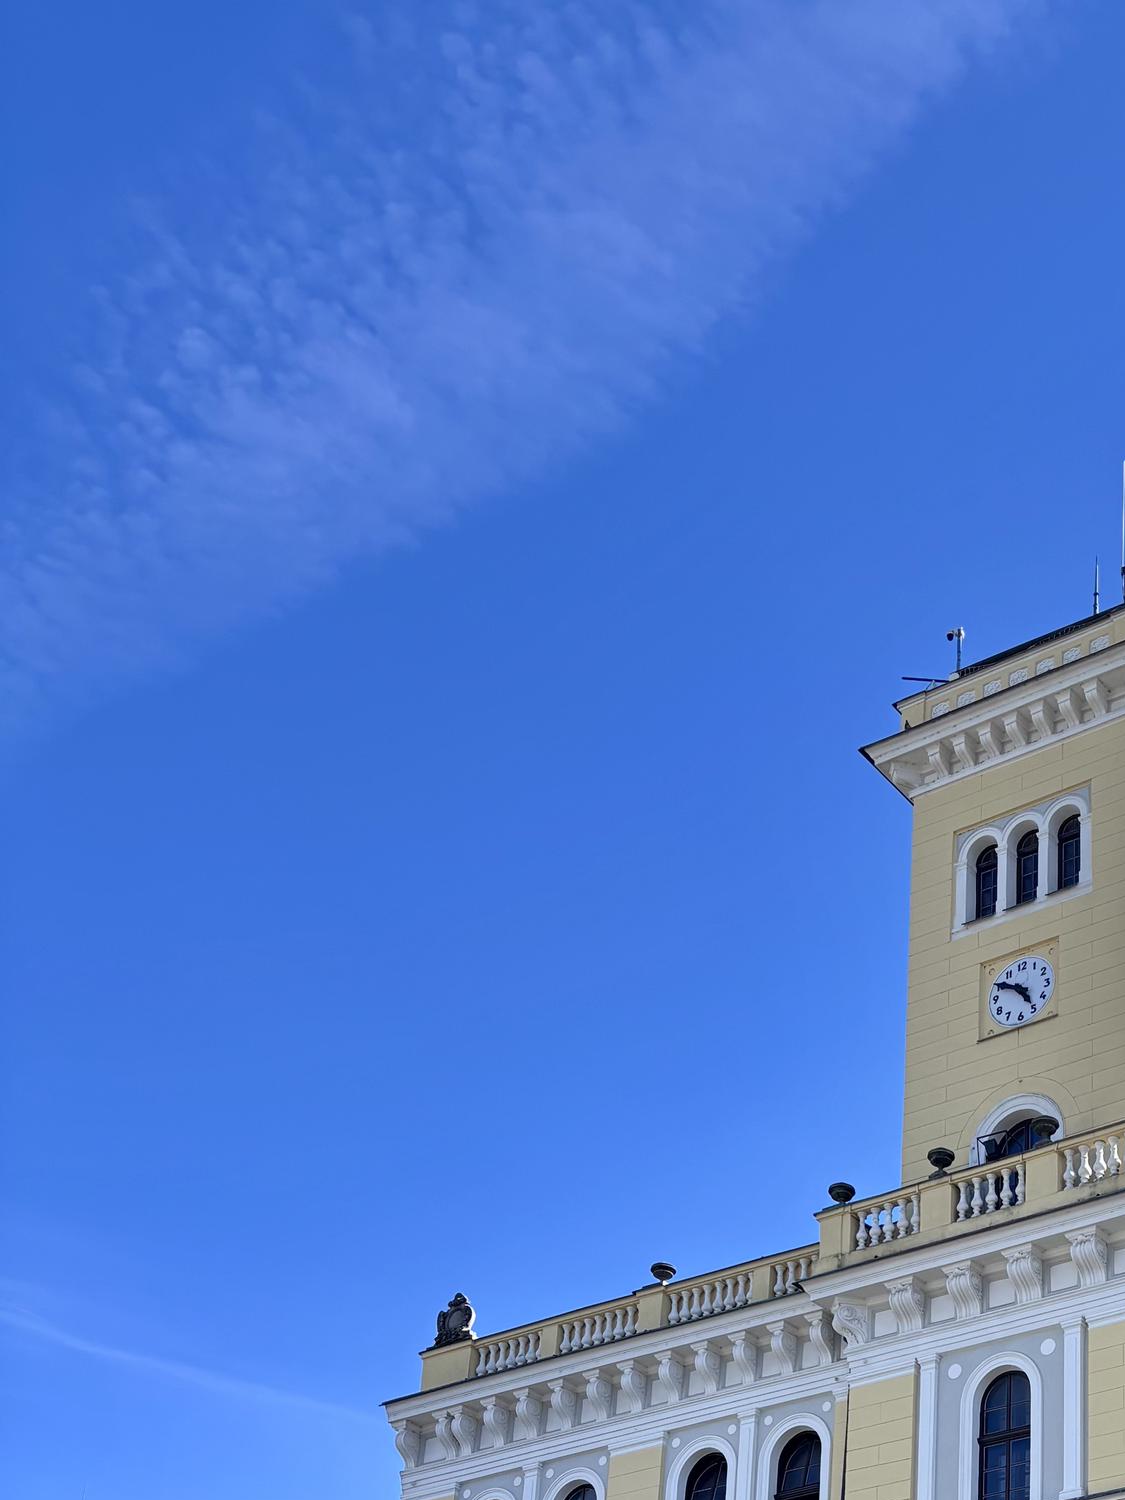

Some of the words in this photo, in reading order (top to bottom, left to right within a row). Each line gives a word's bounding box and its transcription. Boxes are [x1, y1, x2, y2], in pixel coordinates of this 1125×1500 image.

[1017, 961, 1027, 972] 12
[1033, 961, 1037, 970] 1
[1005, 969, 1012, 980] 11
[1040, 966, 1047, 976] 2
[1043, 977, 1051, 988] 3
[992, 995, 999, 1005] 9
[1039, 991, 1047, 1000] 4
[996, 1006, 1003, 1016] 8
[1030, 1003, 1037, 1014] 5
[1005, 1011, 1011, 1022] 7
[1017, 1011, 1024, 1021] 6
